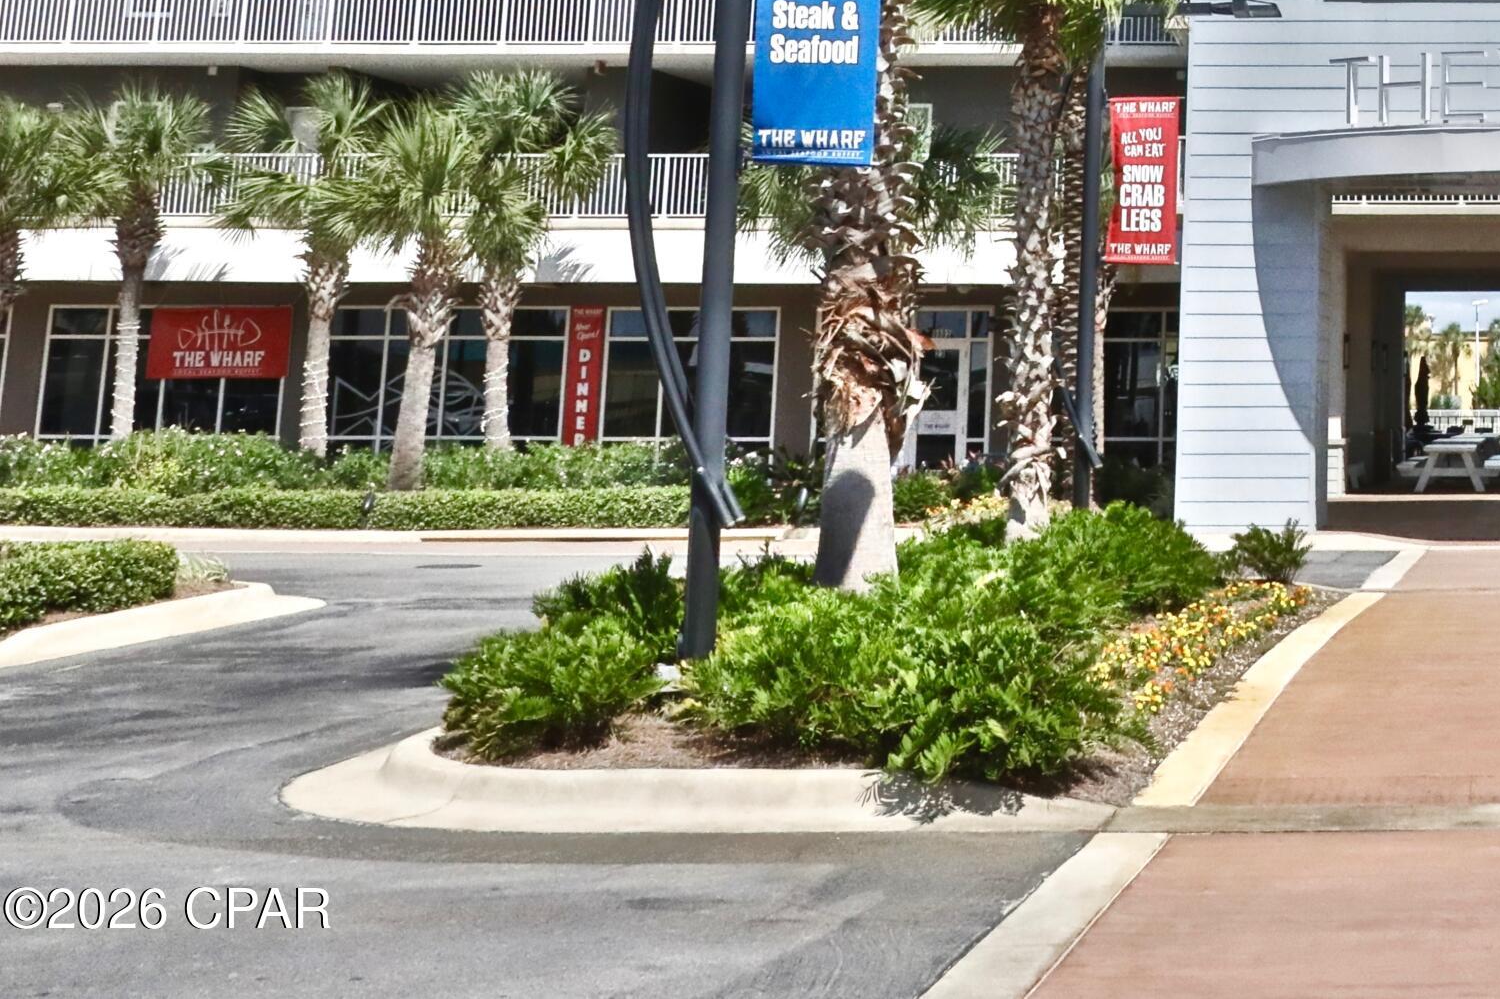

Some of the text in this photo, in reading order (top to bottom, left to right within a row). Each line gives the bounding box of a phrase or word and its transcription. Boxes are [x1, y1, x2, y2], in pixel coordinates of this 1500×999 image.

[772, 0, 859, 31] Steak &
[769, 33, 860, 65] Seafood
[1329, 51, 1488, 127] THE
[1114, 101, 1177, 114] THE WHARF
[758, 128, 866, 150] THE WHARF
[1121, 126, 1163, 145] ALL YOU
[1123, 143, 1167, 158] CAN EAT
[1122, 164, 1165, 183] SNOW
[1119, 184, 1165, 208] CRAB
[1120, 208, 1162, 233] LEGS
[1110, 243, 1172, 255] THE WHARF
[173, 350, 265, 368] THE WHARF
[573, 348, 592, 447] DINNER
